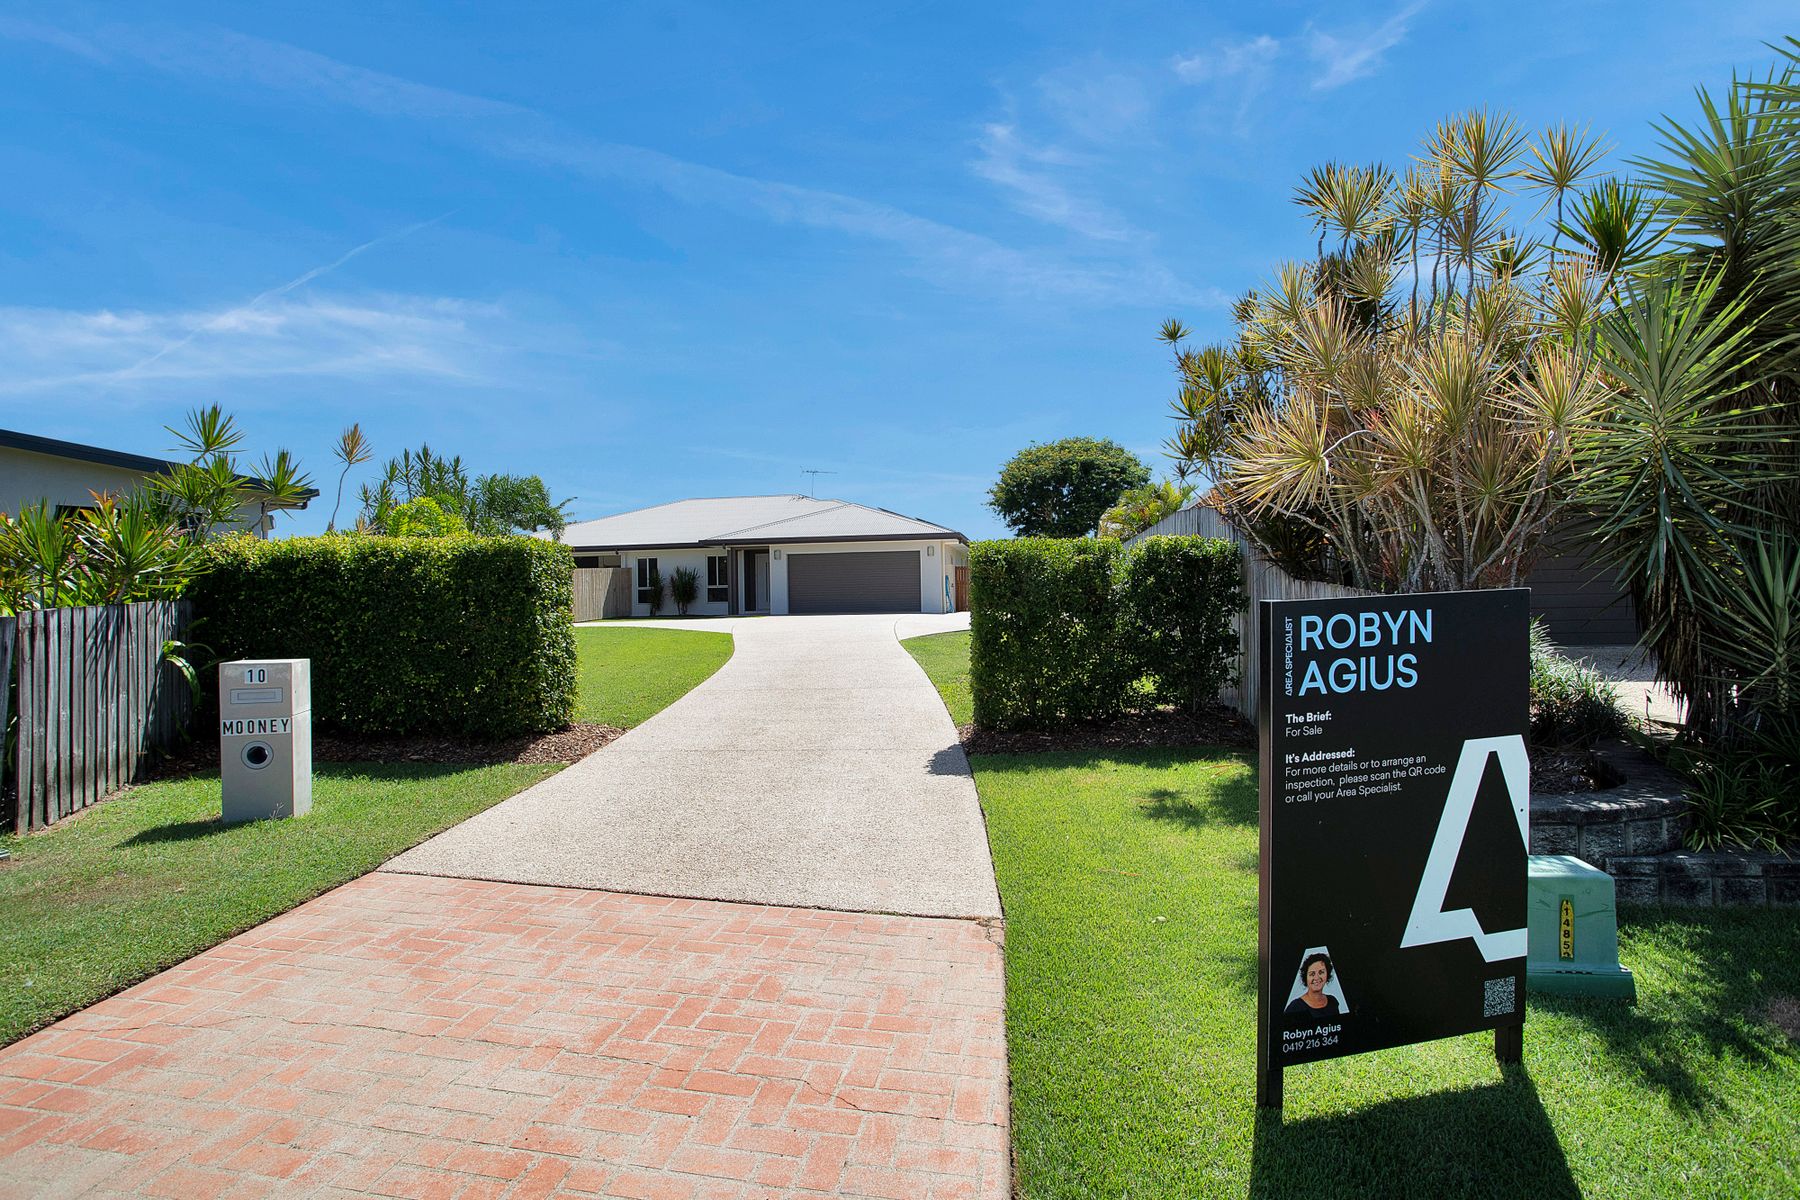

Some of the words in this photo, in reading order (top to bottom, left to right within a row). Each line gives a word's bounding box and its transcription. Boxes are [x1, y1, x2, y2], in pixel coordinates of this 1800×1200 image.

[1301, 609, 1432, 651] ROBYN
[1285, 616, 1293, 670] SPECIALIST
[247, 669, 265, 683] 10
[1298, 653, 1418, 696] AGIUS
[1285, 671, 1293, 696] AREA
[1285, 713, 1305, 724] The
[1306, 710, 1332, 723] Brief:
[222, 719, 289, 735] MOONEY
[1285, 727, 1301, 737] For
[1302, 724, 1323, 736] Sale
[1285, 753, 1300, 764] It's
[1301, 748, 1355, 762] Addressed:
[1285, 767, 1301, 777] For
[1302, 765, 1327, 775] more
[1328, 760, 1358, 773] details
[1359, 761, 1370, 770] or
[1370, 759, 1381, 768] to
[1381, 756, 1415, 768] arrange
[1415, 755, 1427, 764] an
[1339, 773, 1369, 788] please
[1370, 771, 1391, 782] scan
[1392, 768, 1407, 779] the
[1408, 766, 1423, 777] QR
[1423, 763, 1447, 775] code
[1284, 795, 1296, 804] or
[1296, 791, 1313, 802] call
[1314, 791, 1335, 803] your
[1335, 787, 1357, 798] Area
[1283, 1029, 1314, 1041] Robyn
[1315, 1024, 1341, 1036] Agius
[1282, 1041, 1304, 1053] 0419
[1305, 1038, 1321, 1049] 216
[1322, 1035, 1338, 1046] 364
